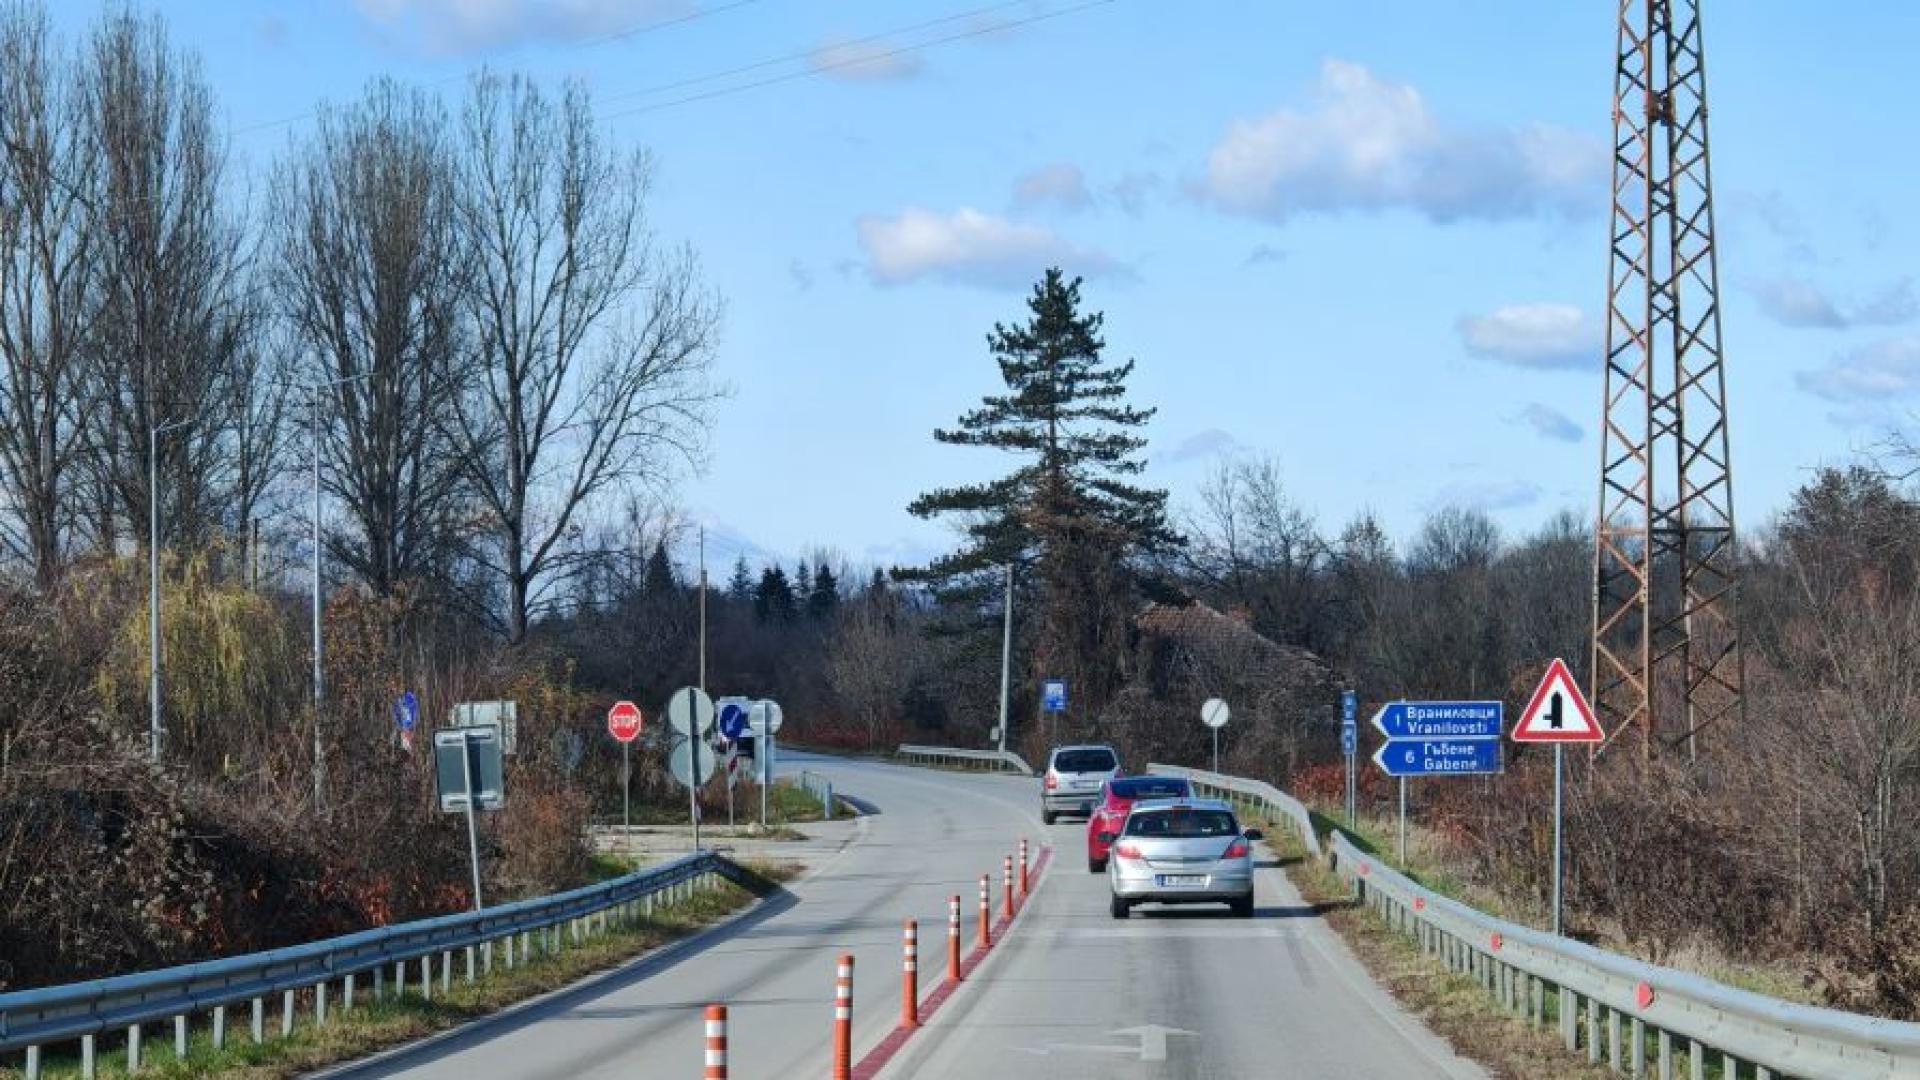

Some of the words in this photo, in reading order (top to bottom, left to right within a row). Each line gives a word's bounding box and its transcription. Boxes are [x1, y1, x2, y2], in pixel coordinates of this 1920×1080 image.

[1407, 706, 1495, 720] Враниловци
[612, 713, 637, 729] STOP
[1424, 743, 1475, 755] Гъбене
[1405, 750, 1415, 763] 6
[1424, 758, 1477, 770] Gabene
